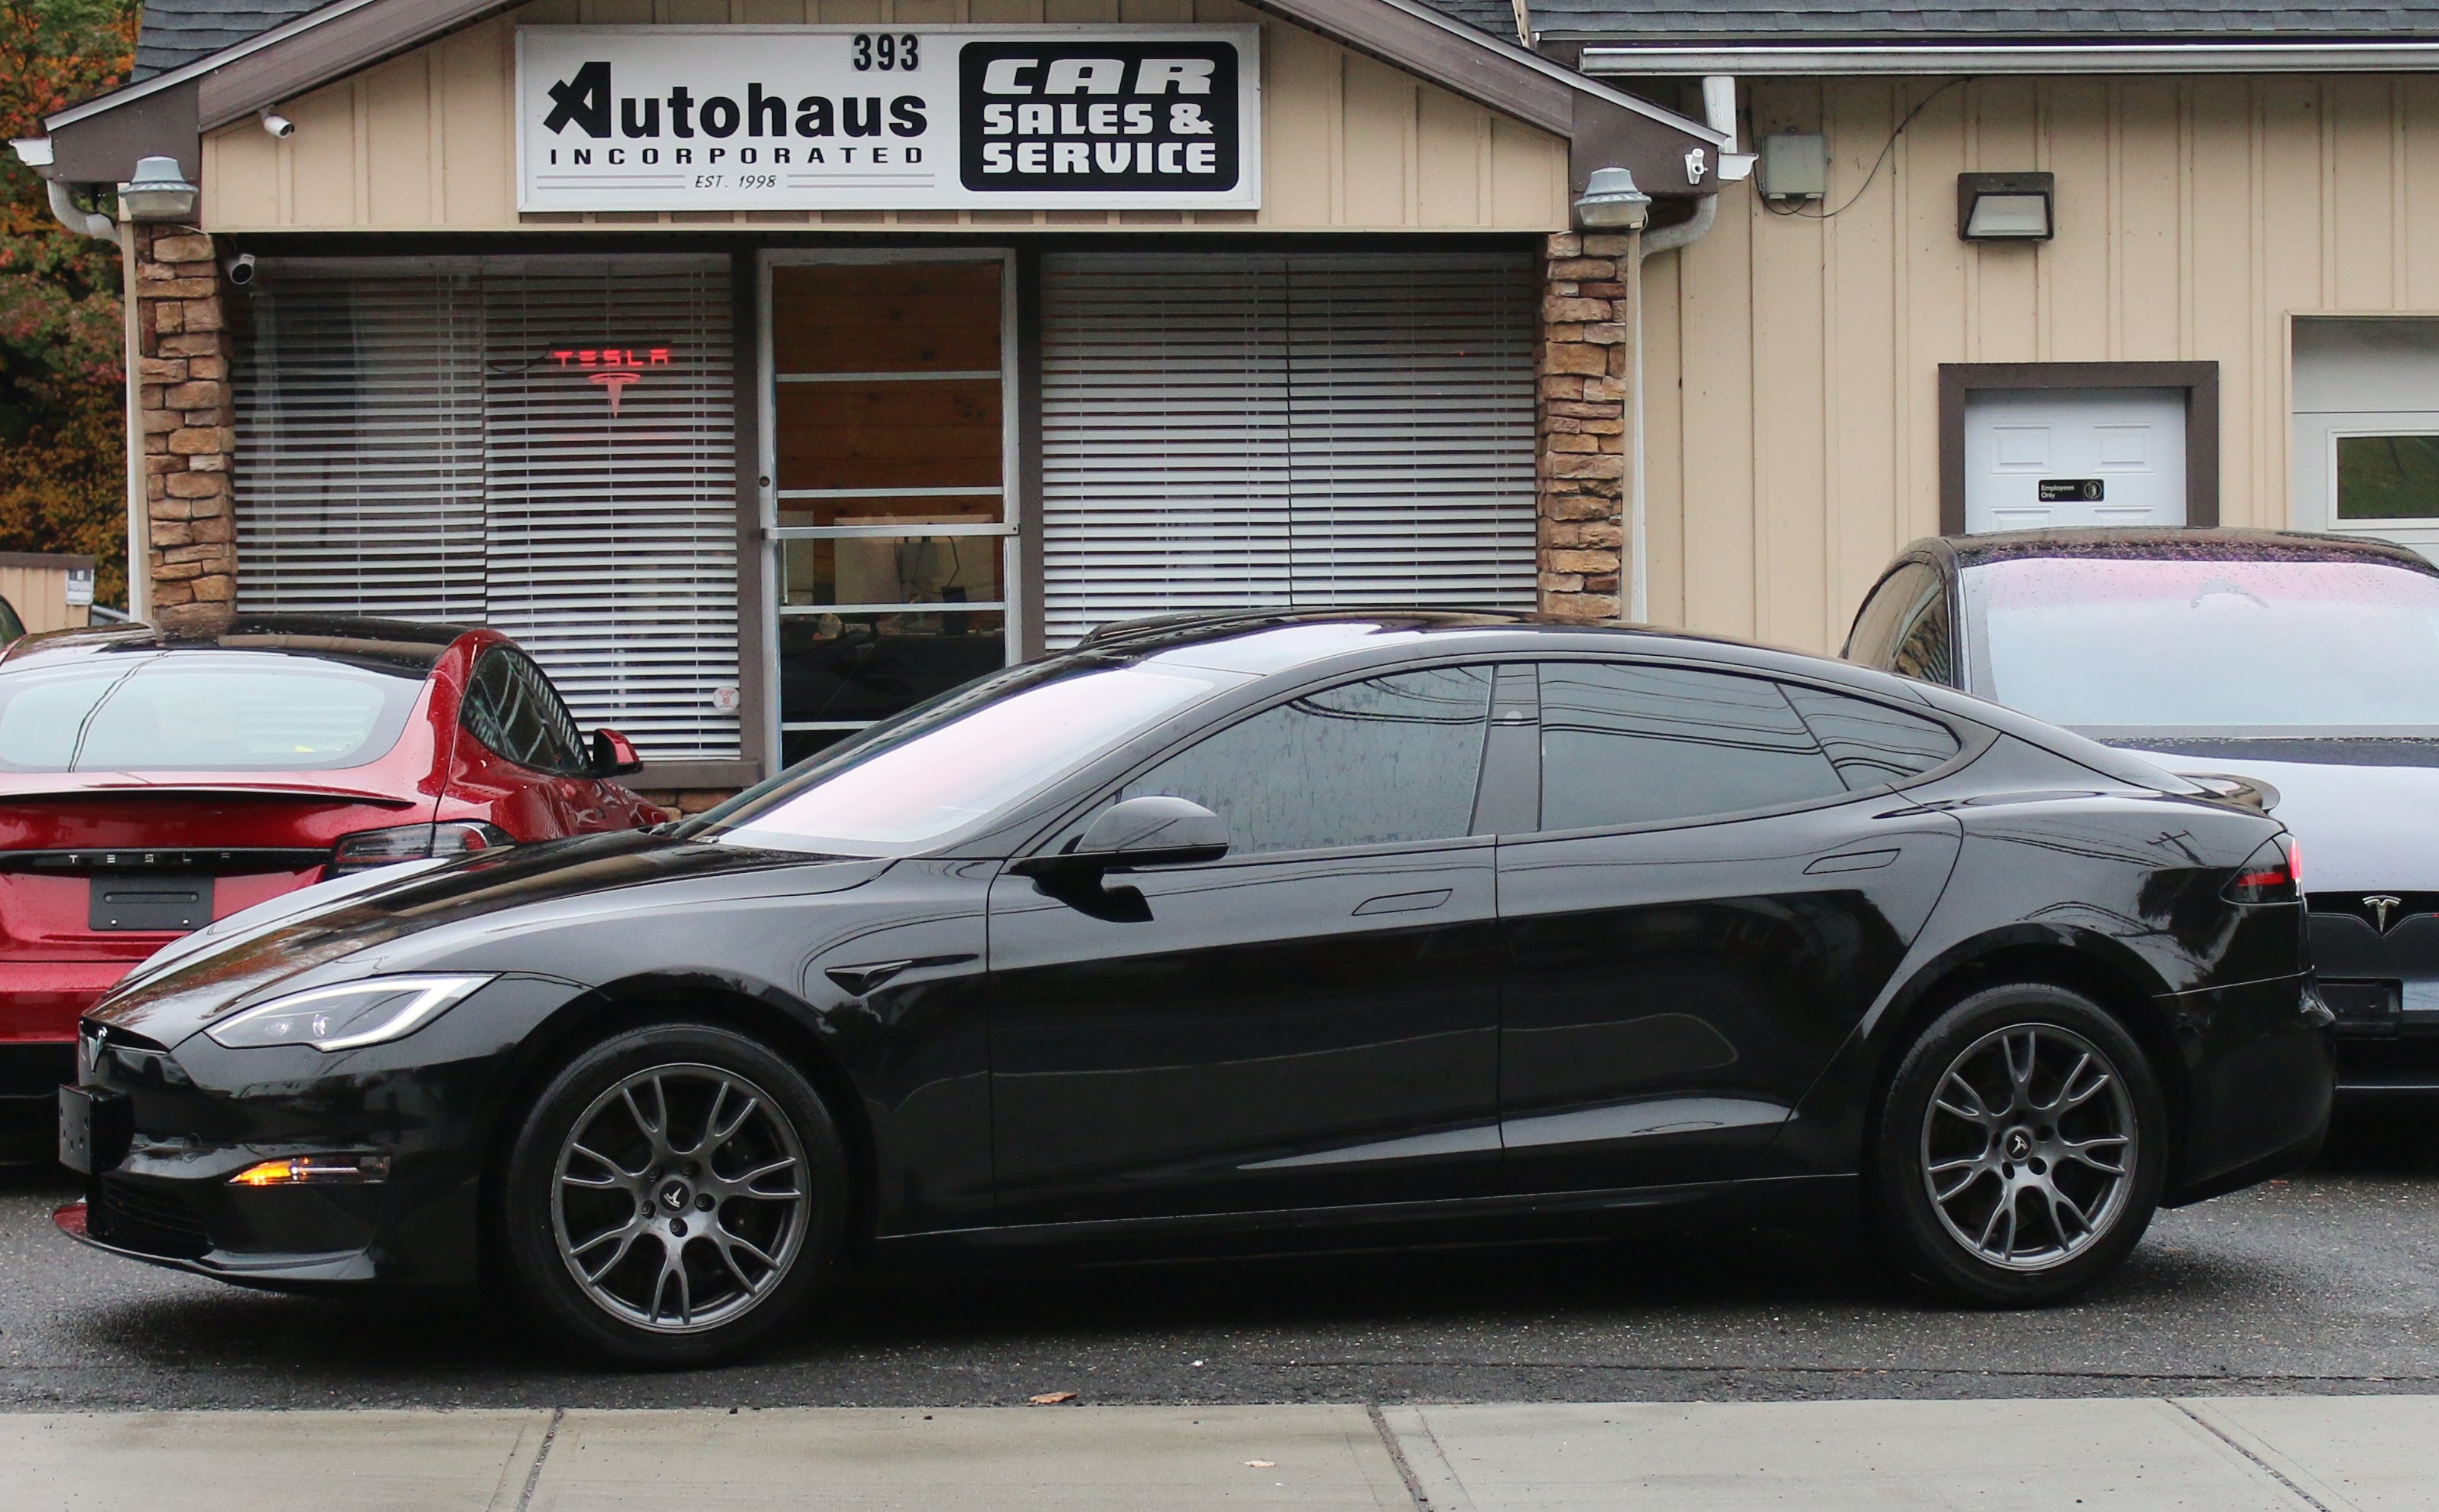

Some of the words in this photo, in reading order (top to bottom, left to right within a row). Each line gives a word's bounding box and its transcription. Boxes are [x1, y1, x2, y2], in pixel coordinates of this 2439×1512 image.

[853, 34, 919, 71] 393
[982, 58, 1216, 94] CAR
[543, 61, 927, 138] Autohaus
[983, 103, 1154, 135] SALES
[1169, 102, 1214, 135] &
[550, 147, 923, 165] INCORPORATED
[982, 142, 1216, 174] SERVICE
[694, 175, 729, 189] EST.
[738, 174, 777, 189] 1998
[554, 348, 669, 368] TESLA
